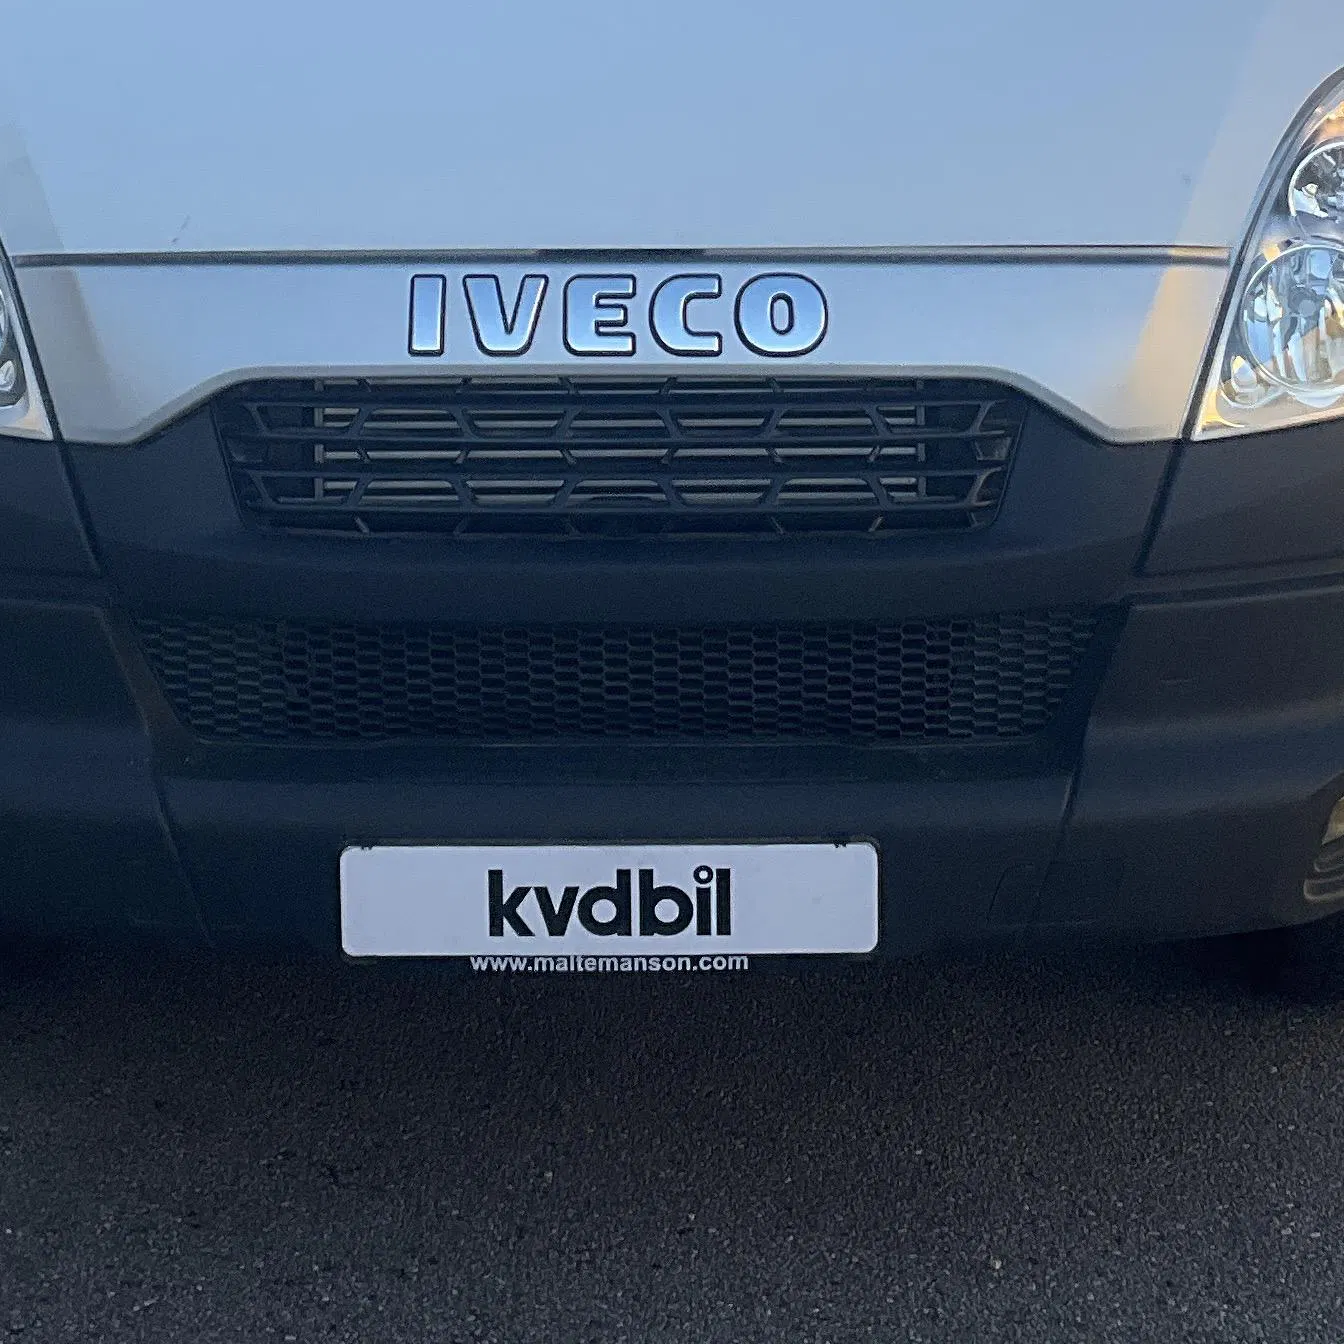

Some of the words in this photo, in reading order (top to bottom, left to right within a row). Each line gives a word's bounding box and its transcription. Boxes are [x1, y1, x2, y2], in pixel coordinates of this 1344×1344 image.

[407, 272, 829, 357] IVECO
[488, 865, 732, 937] kvdbil
[470, 955, 749, 972] www.maltemanson.com
